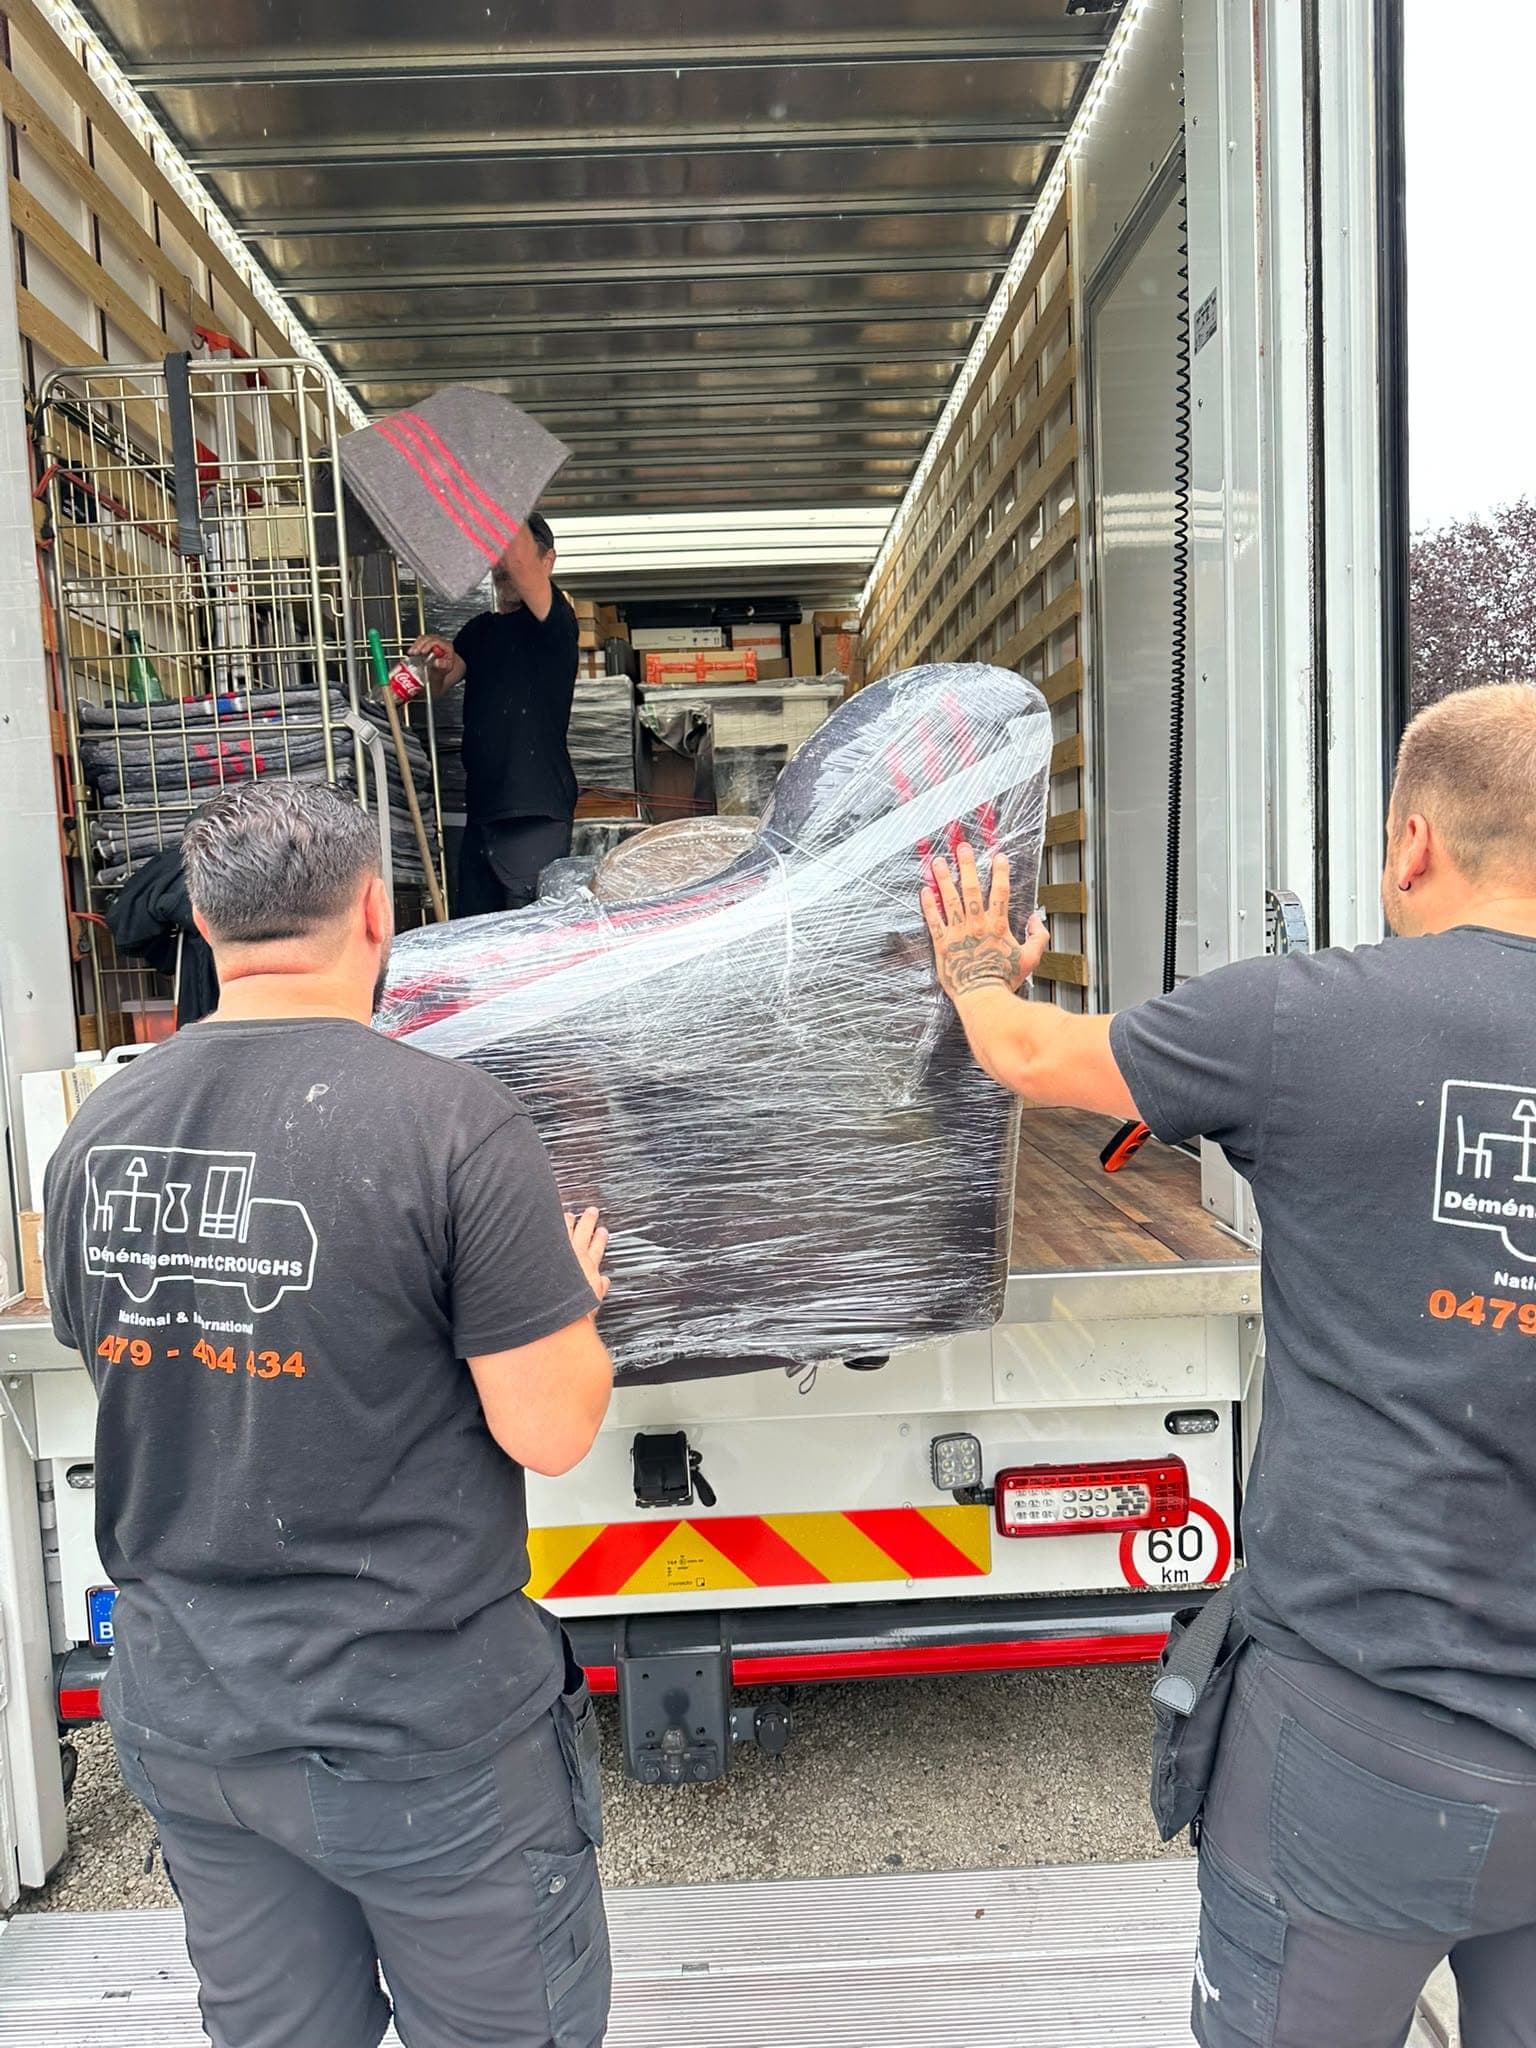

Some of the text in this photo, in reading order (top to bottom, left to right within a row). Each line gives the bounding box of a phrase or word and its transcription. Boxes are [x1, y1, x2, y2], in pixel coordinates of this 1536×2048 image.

[1443, 1190, 1536, 1219] Démén
[1493, 1271, 1536, 1291] Nati
[176, 1311, 189, 1324] &
[1428, 1289, 1536, 1335] 0479
[1148, 1525, 1203, 1563] 60
[1162, 1566, 1188, 1583] km
[99, 1621, 114, 1639] B
